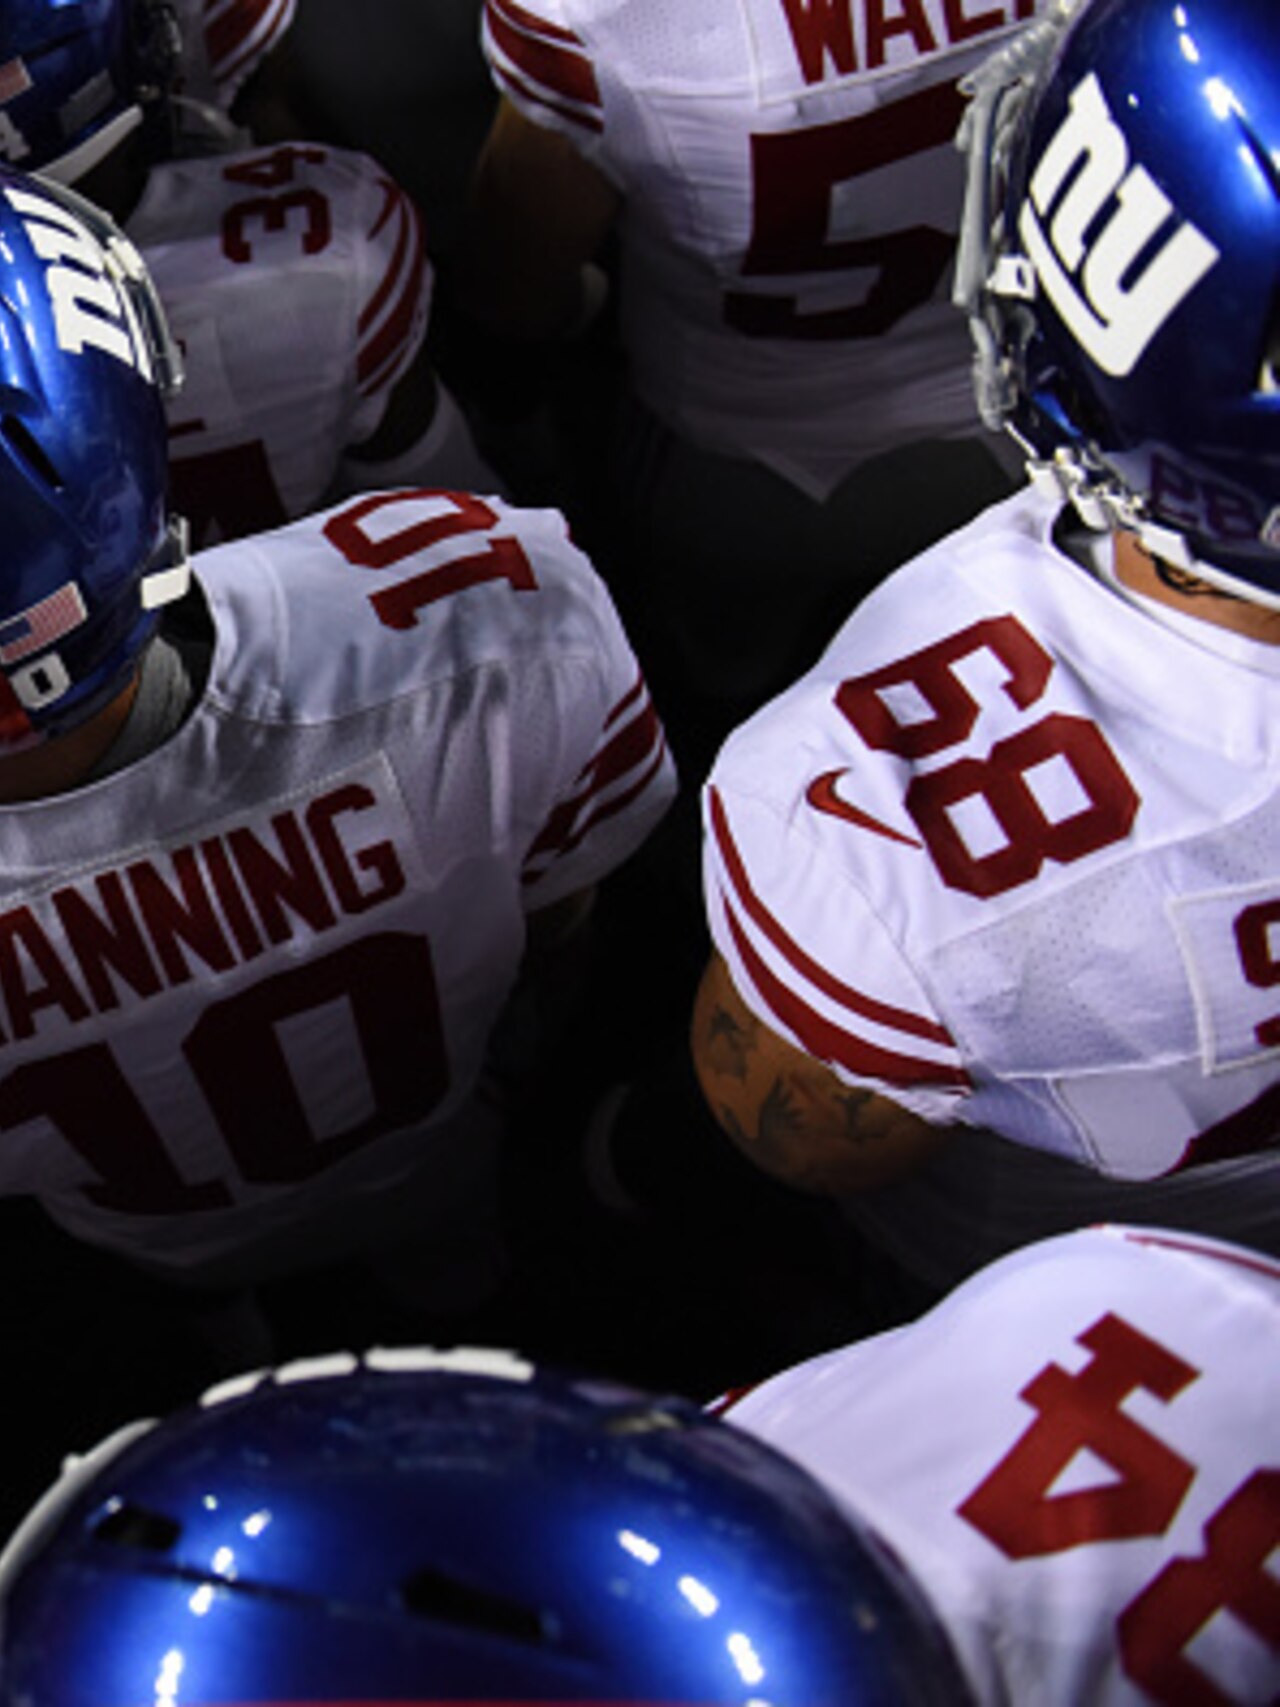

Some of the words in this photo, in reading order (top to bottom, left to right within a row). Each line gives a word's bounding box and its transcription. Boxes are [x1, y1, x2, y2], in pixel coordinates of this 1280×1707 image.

[224, 147, 332, 263] 34
[323, 487, 539, 629] 10
[833, 614, 1142, 899] 68
